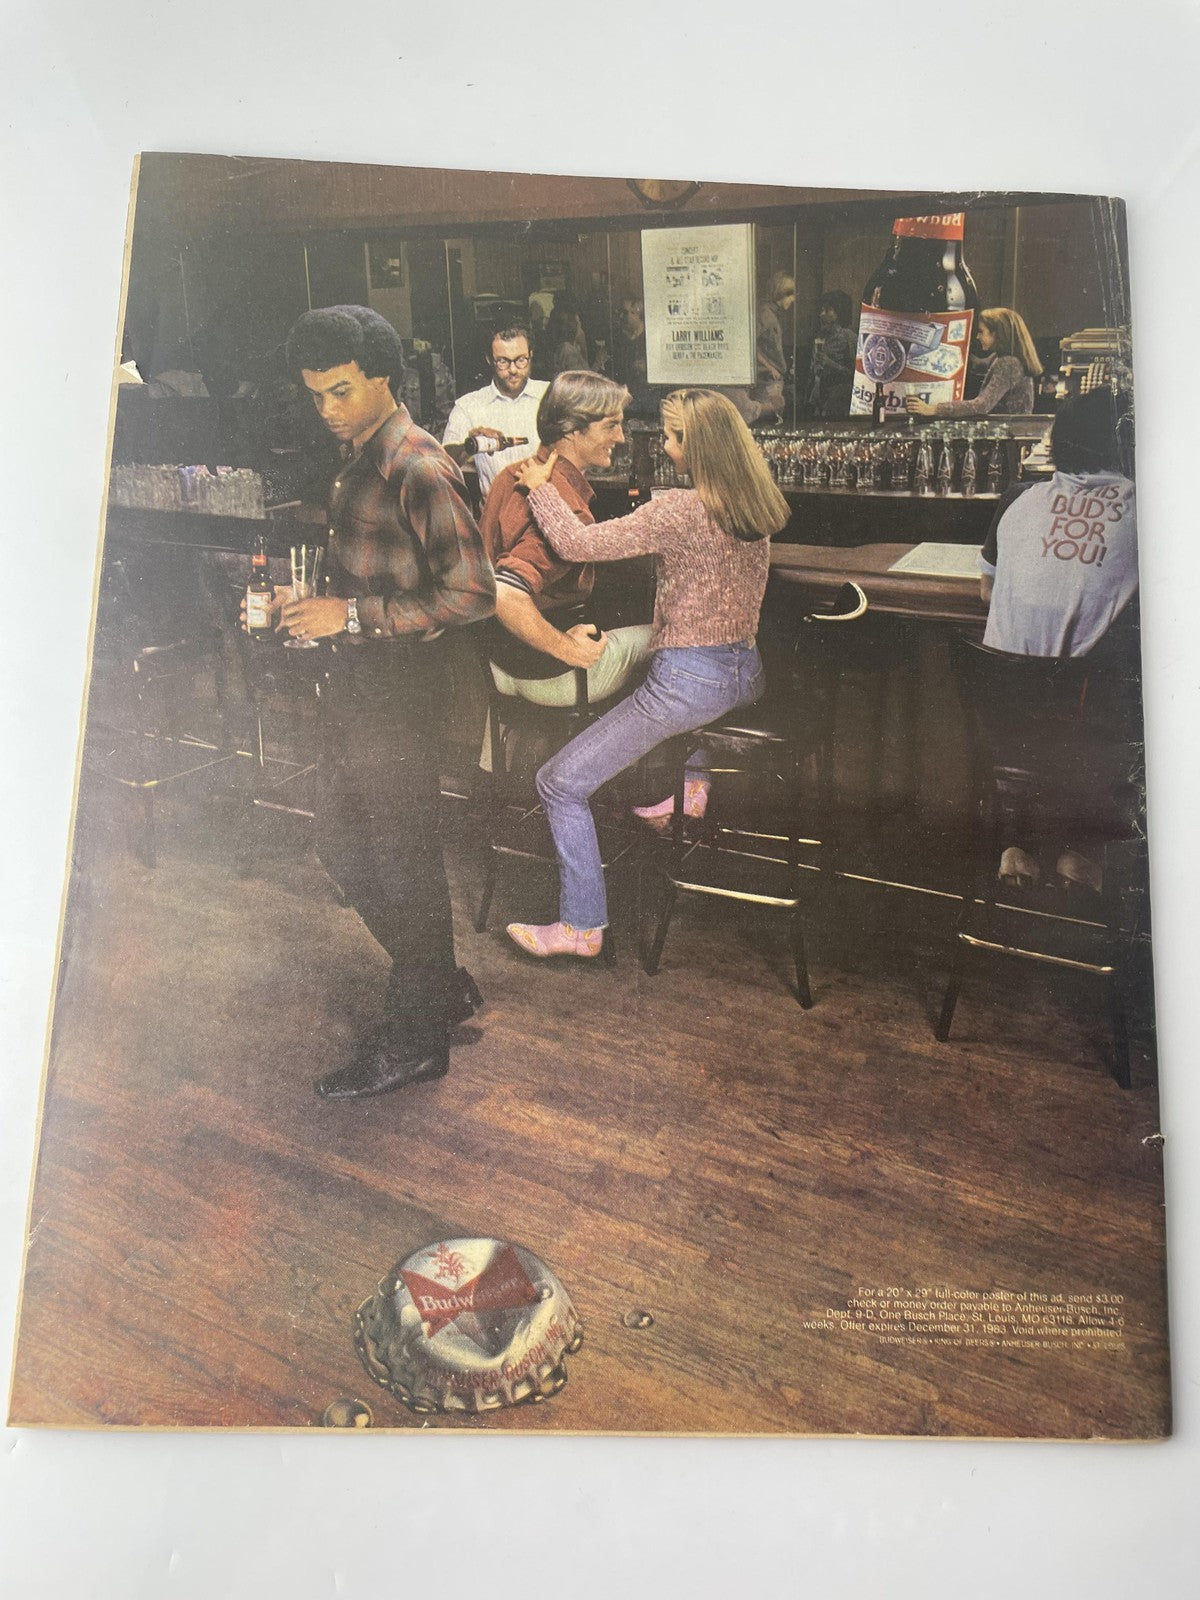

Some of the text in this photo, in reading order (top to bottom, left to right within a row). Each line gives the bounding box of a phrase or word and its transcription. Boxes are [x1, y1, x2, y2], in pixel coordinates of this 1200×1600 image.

[672, 330, 724, 342] LARRY WILLIAMS
[1051, 494, 1123, 523] BUD'S
[1050, 516, 1106, 544] FOR
[1041, 537, 1108, 568] YOU!
[858, 1287, 876, 1297] For
[878, 1289, 884, 1297] a
[935, 1288, 979, 1300] full-color
[983, 1290, 1016, 1302] poster
[1017, 1290, 1027, 1300] of
[1030, 1292, 1048, 1303] this
[1069, 1293, 1092, 1304] send
[1096, 1293, 1124, 1305] $3.00
[847, 1298, 877, 1309] check
[879, 1301, 890, 1309] or
[893, 1301, 926, 1311] money
[930, 1300, 957, 1311] order
[960, 1301, 1000, 1313] payable
[1002, 1303, 1012, 1312] to
[879, 1310, 901, 1320] One
[904, 1310, 936, 1320] Busch
[1022, 1314, 1040, 1324] MO
[1078, 1315, 1106, 1326] Allow
[1108, 1317, 1125, 1327] 4-6
[840, 1319, 866, 1330] Offer
[869, 1321, 906, 1333] expires
[908, 1321, 960, 1333] December
[1012, 1325, 1034, 1335] Void
[1037, 1326, 1069, 1336] where
